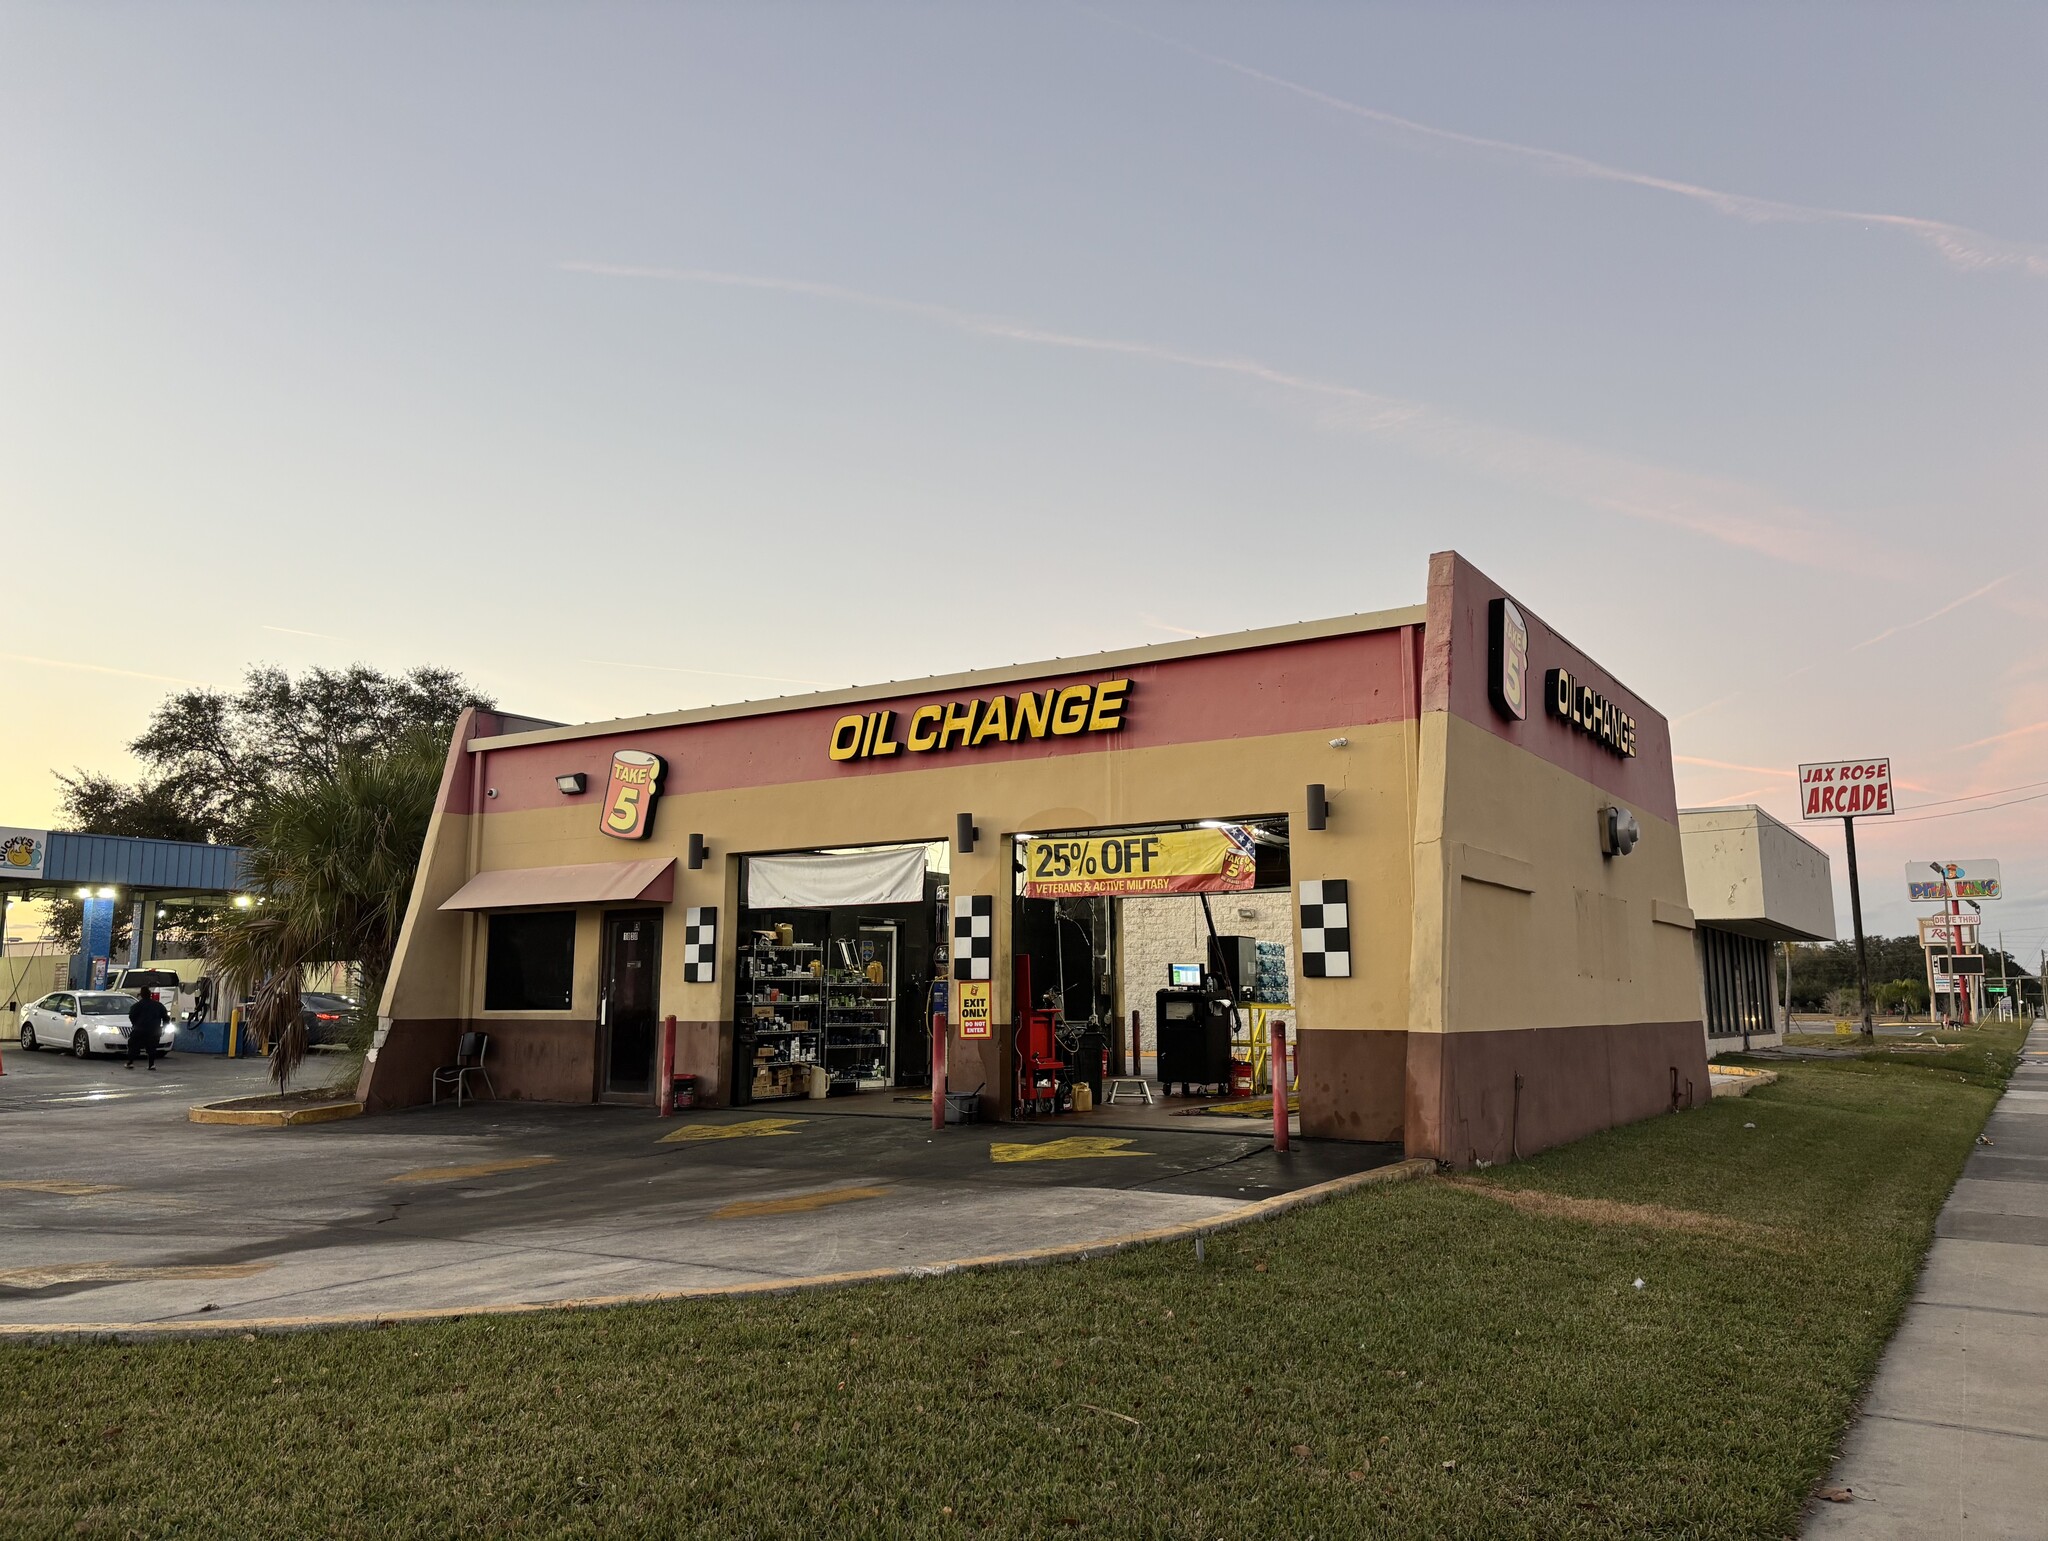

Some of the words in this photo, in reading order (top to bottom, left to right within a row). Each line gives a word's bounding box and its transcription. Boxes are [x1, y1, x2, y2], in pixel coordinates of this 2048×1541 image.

[1505, 618, 1522, 650] TAKE
[1506, 648, 1522, 706] 5
[829, 710, 898, 761] OIL
[907, 678, 1129, 751] CHANGE
[1558, 668, 1581, 723] OIL
[1583, 686, 1636, 758] CHANGE
[614, 763, 648, 784] TAKE
[1803, 768, 1835, 783] JAX
[1840, 764, 1887, 780] ROSE
[1806, 783, 1888, 814] ARCADE
[607, 786, 638, 832] 5
[1036, 841, 1097, 877] 25%
[1101, 837, 1159, 874] OFF
[1225, 852, 1244, 865] TAKE
[1226, 863, 1239, 877] 5
[1036, 882, 1082, 894] VETERANS
[1084, 882, 1091, 891] &
[1094, 880, 1125, 891] ACTIVE
[1126, 878, 1170, 890] MILITARY
[1909, 882, 1952, 899] PITA
[1955, 879, 1999, 897] KING
[1934, 916, 1956, 924] DRVE
[962, 1009, 988, 1017] ONLY
[964, 999, 986, 1007] EXIT
